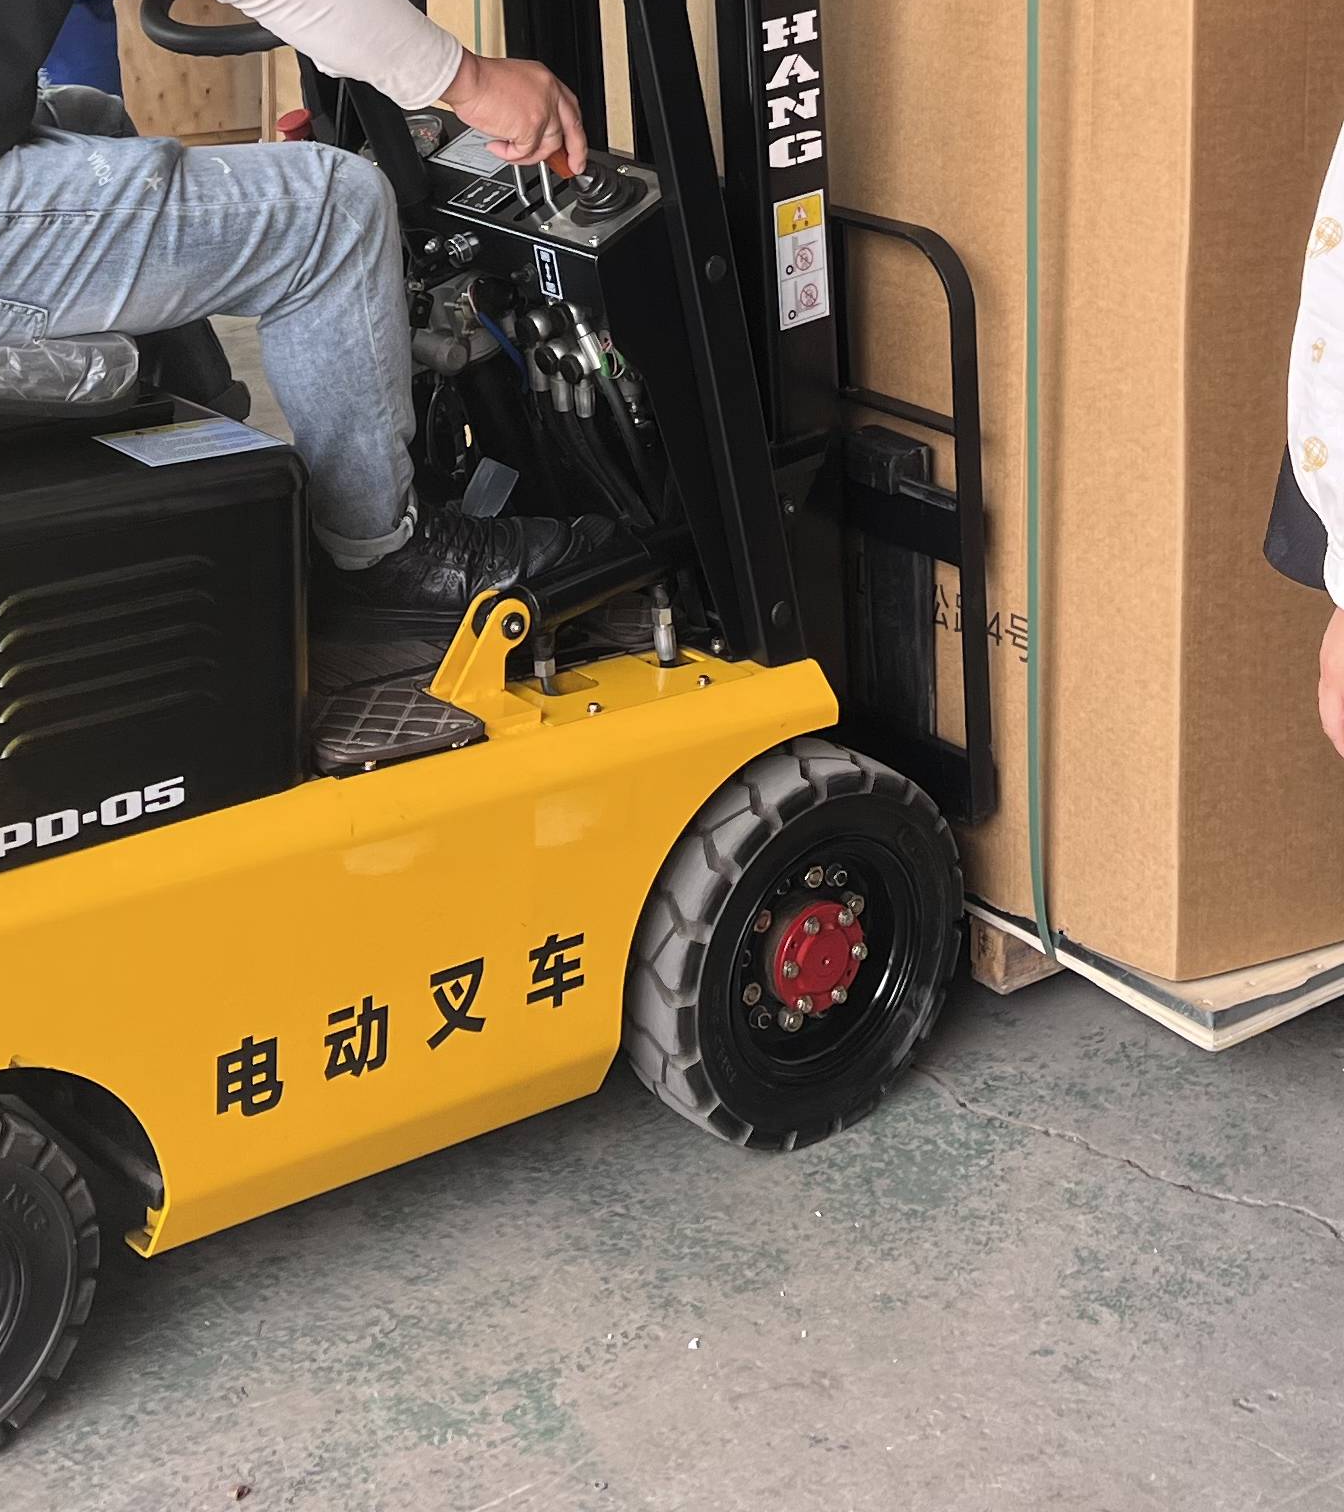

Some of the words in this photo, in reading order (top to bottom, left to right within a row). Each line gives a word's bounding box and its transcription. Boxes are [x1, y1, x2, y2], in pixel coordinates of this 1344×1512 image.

[762, 9, 824, 169] HANG
[215, 931, 586, 1119] 电动叉车
